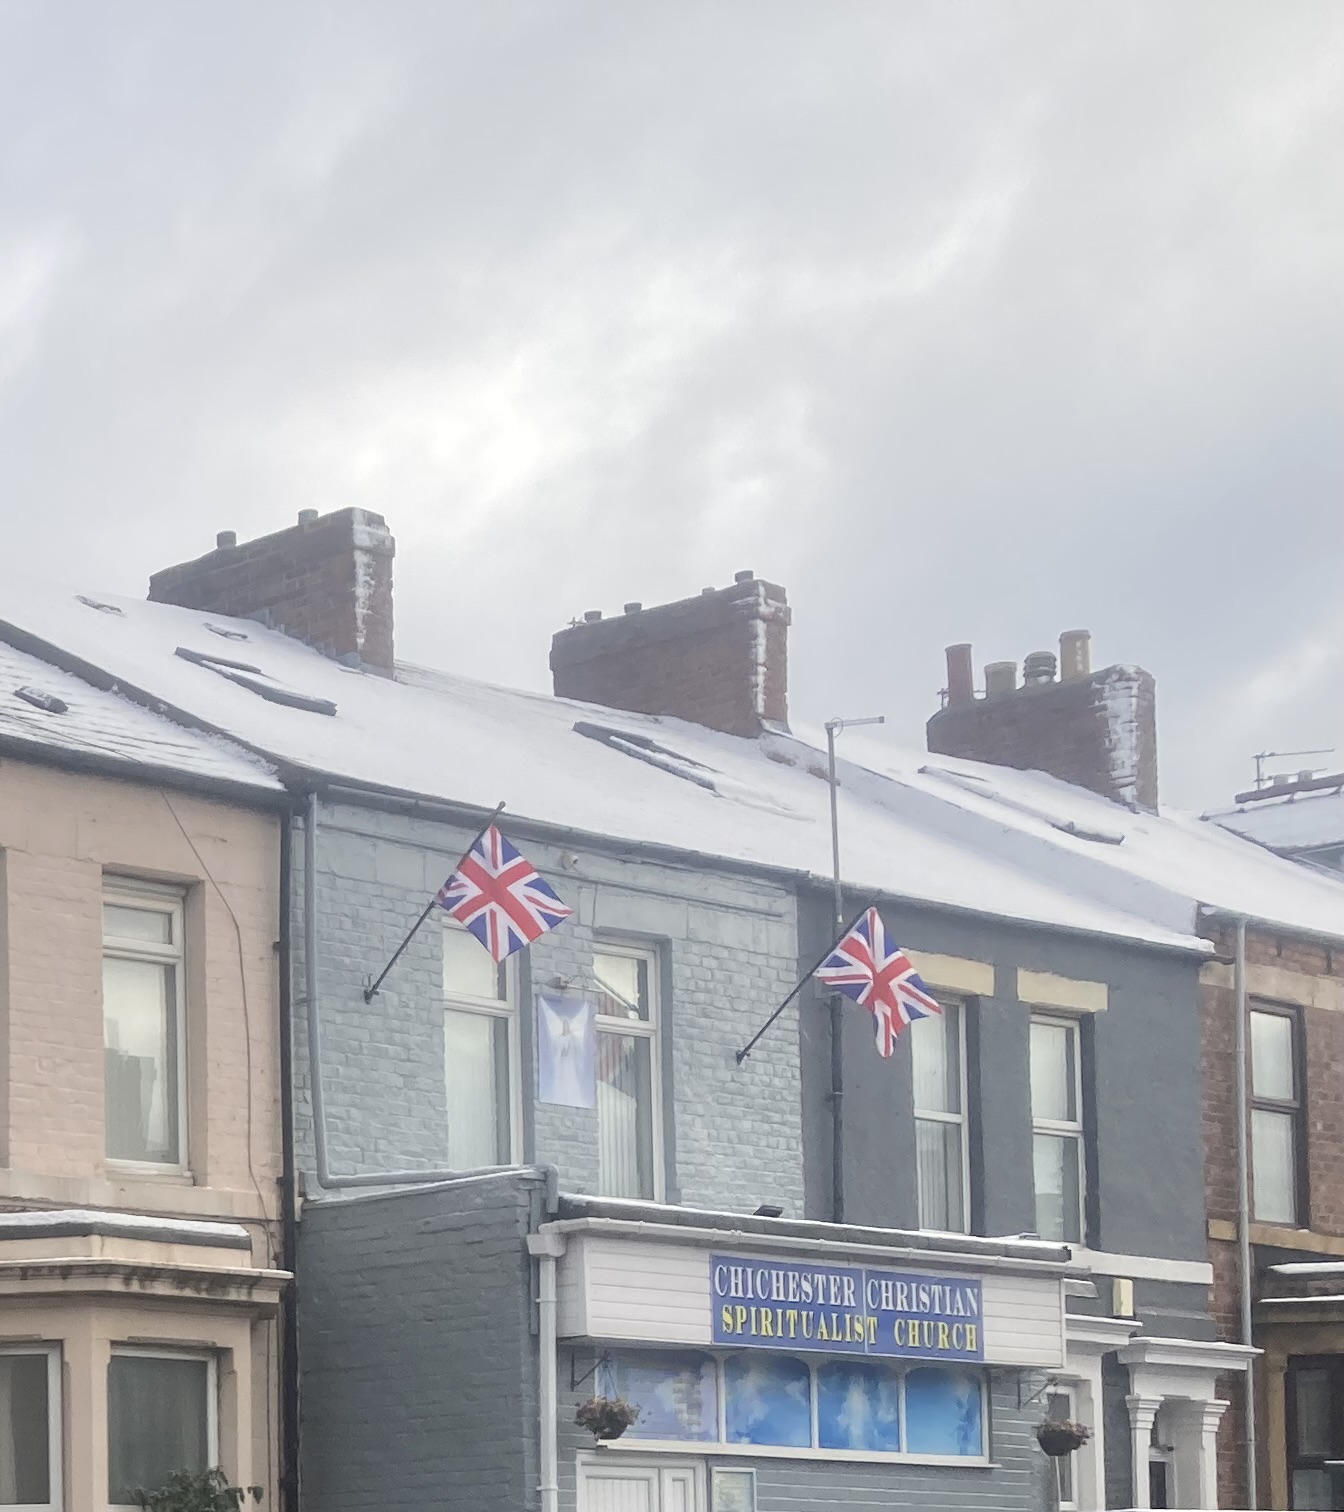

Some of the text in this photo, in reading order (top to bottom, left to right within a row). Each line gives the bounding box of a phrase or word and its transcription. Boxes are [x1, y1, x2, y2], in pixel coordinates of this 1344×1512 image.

[714, 1264, 979, 1317] CHICHESTER CHRISTIAN
[722, 1304, 977, 1352] SPIRITUALIST CHURCH
